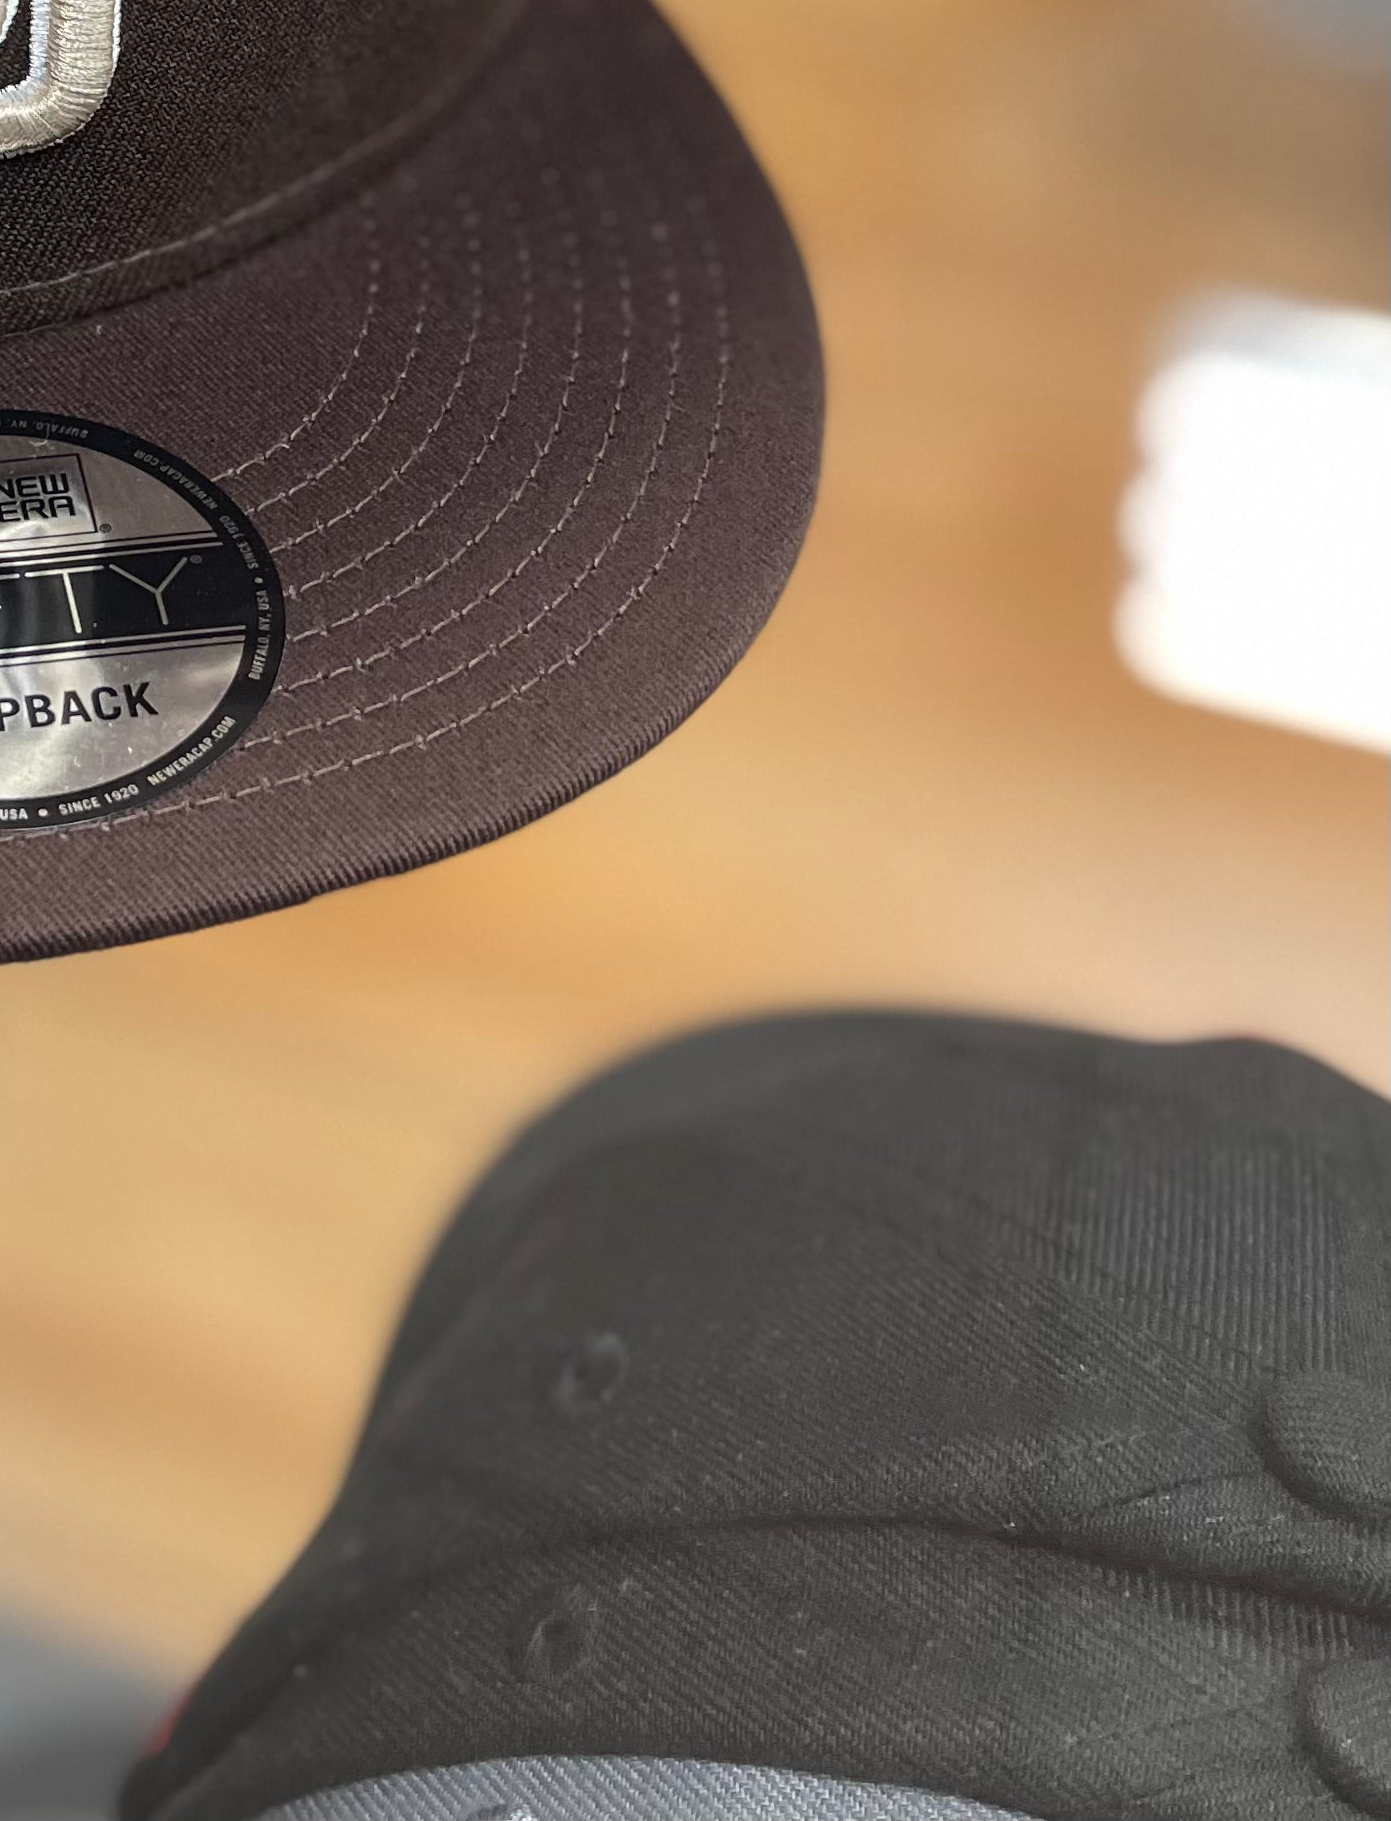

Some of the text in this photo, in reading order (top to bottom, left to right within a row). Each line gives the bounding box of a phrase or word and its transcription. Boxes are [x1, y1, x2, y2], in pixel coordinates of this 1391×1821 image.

[219, 515, 244, 540] 1920
[237, 541, 259, 570] SINCE
[255, 589, 271, 611] USA
[0, 808, 29, 820] USA
[58, 796, 101, 815] SINCE
[104, 784, 139, 804] 1920
[146, 715, 236, 786] NEWERACAP.COM
